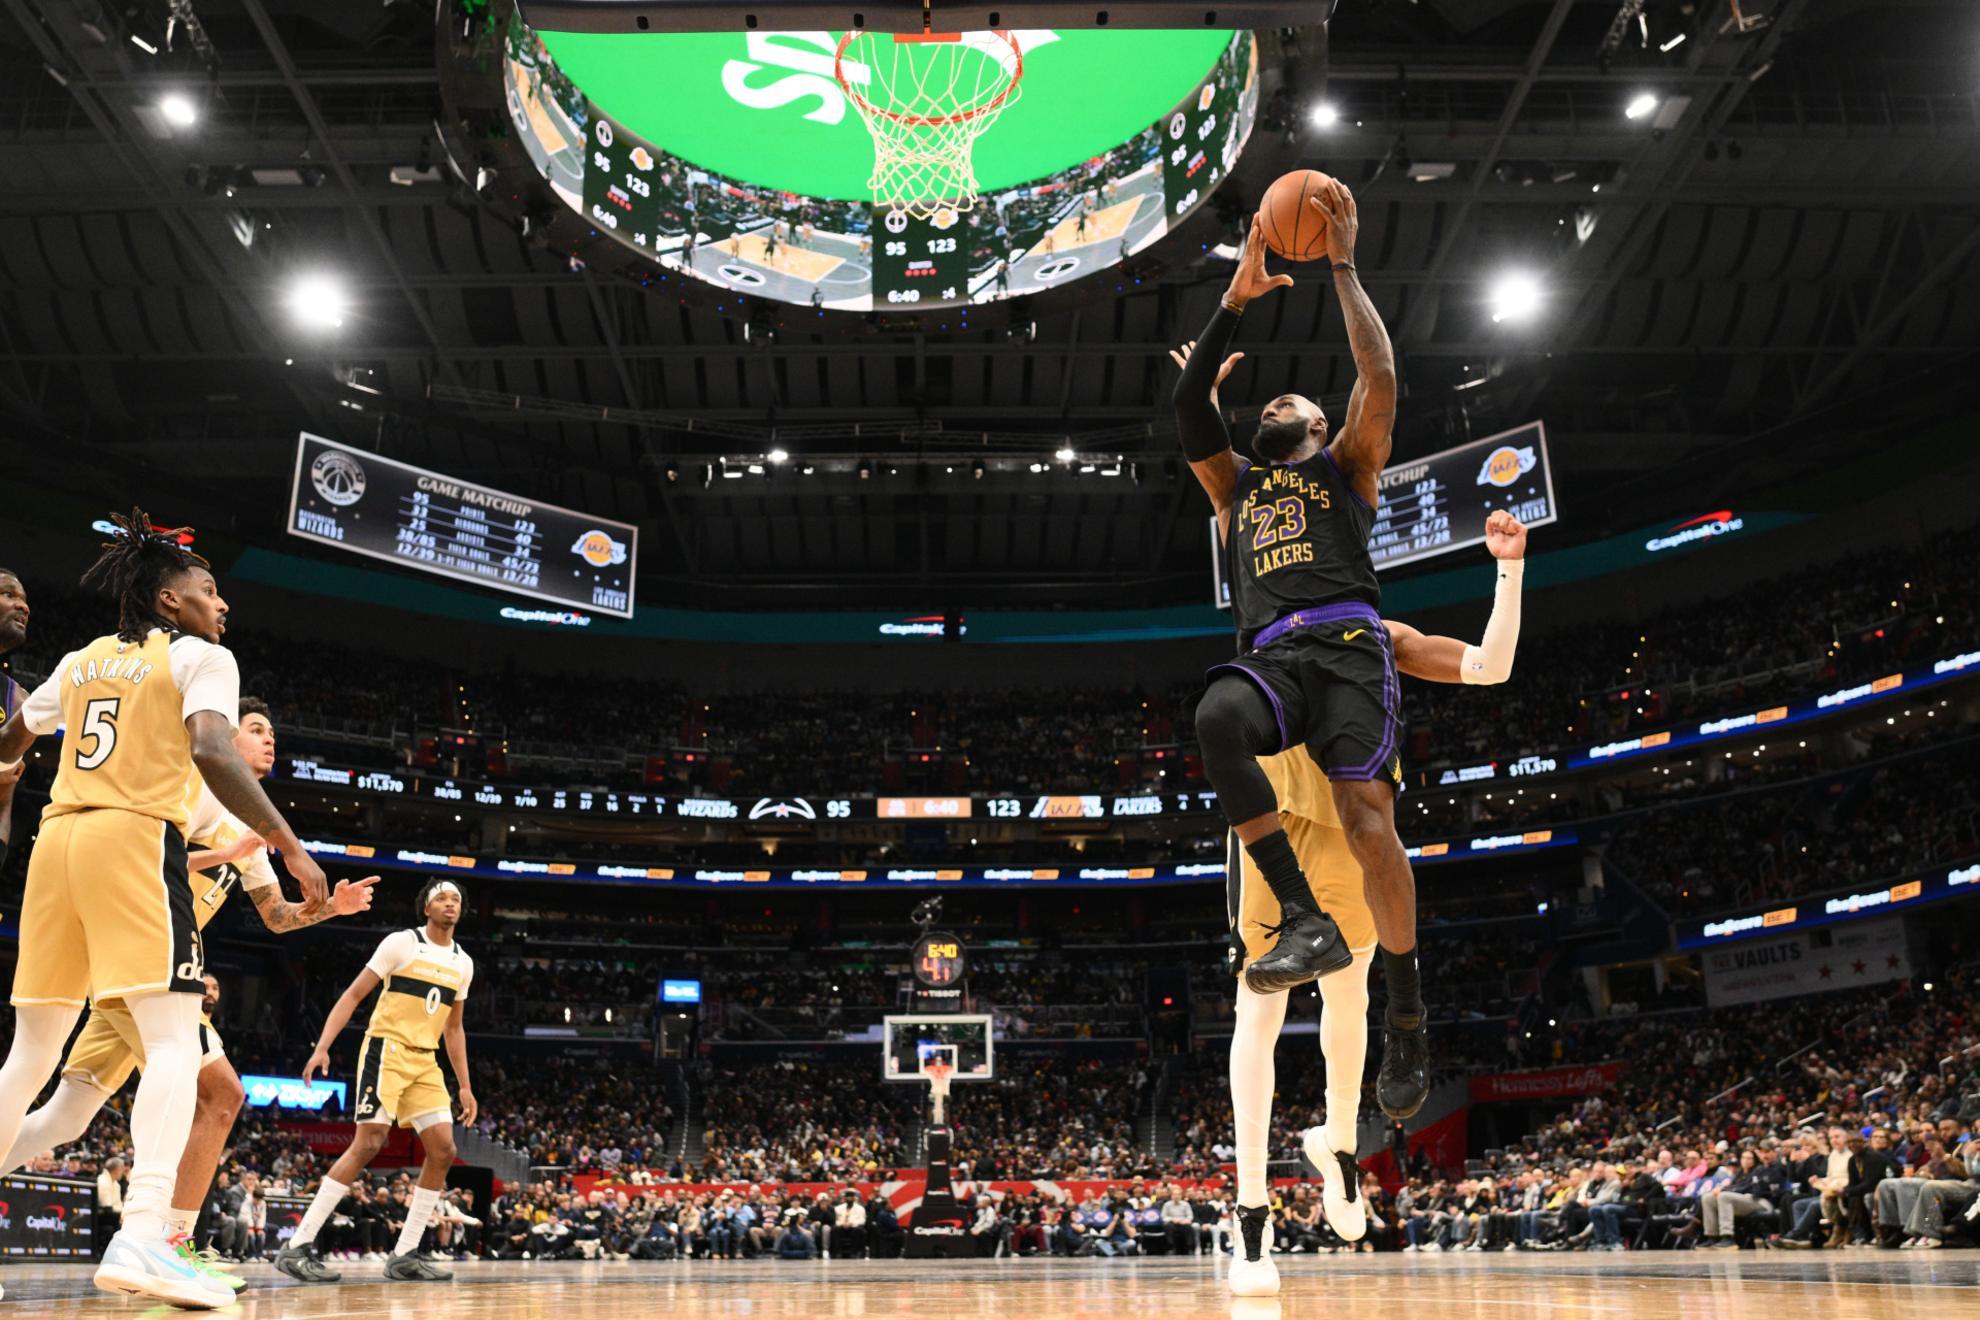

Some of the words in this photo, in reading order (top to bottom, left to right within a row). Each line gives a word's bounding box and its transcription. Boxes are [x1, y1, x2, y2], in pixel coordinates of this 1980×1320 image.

[625, 173, 650, 197] 123
[885, 241, 907, 256] 95
[926, 238, 956, 254] 123
[887, 289, 920, 303] 6:40
[1377, 464, 1429, 490] ATCHUP
[417, 476, 460, 498] GAME
[461, 490, 531, 517] MATCHUP
[1238, 489, 1258, 533] LOS
[1262, 468, 1330, 509] ANGELES
[1251, 496, 1306, 551] 23
[1254, 543, 1313, 577] LAKERS
[70, 658, 153, 688] WATKINS
[75, 697, 121, 771] 5
[358, 776, 404, 792] $11,570
[827, 800, 850, 817] 95
[923, 799, 959, 815] 6:40
[986, 800, 1021, 817] 123
[928, 943, 957, 958] 6:40
[1733, 941, 1801, 969] VAULTS
[425, 986, 441, 1016] 0
[928, 989, 962, 998] TISSOT
